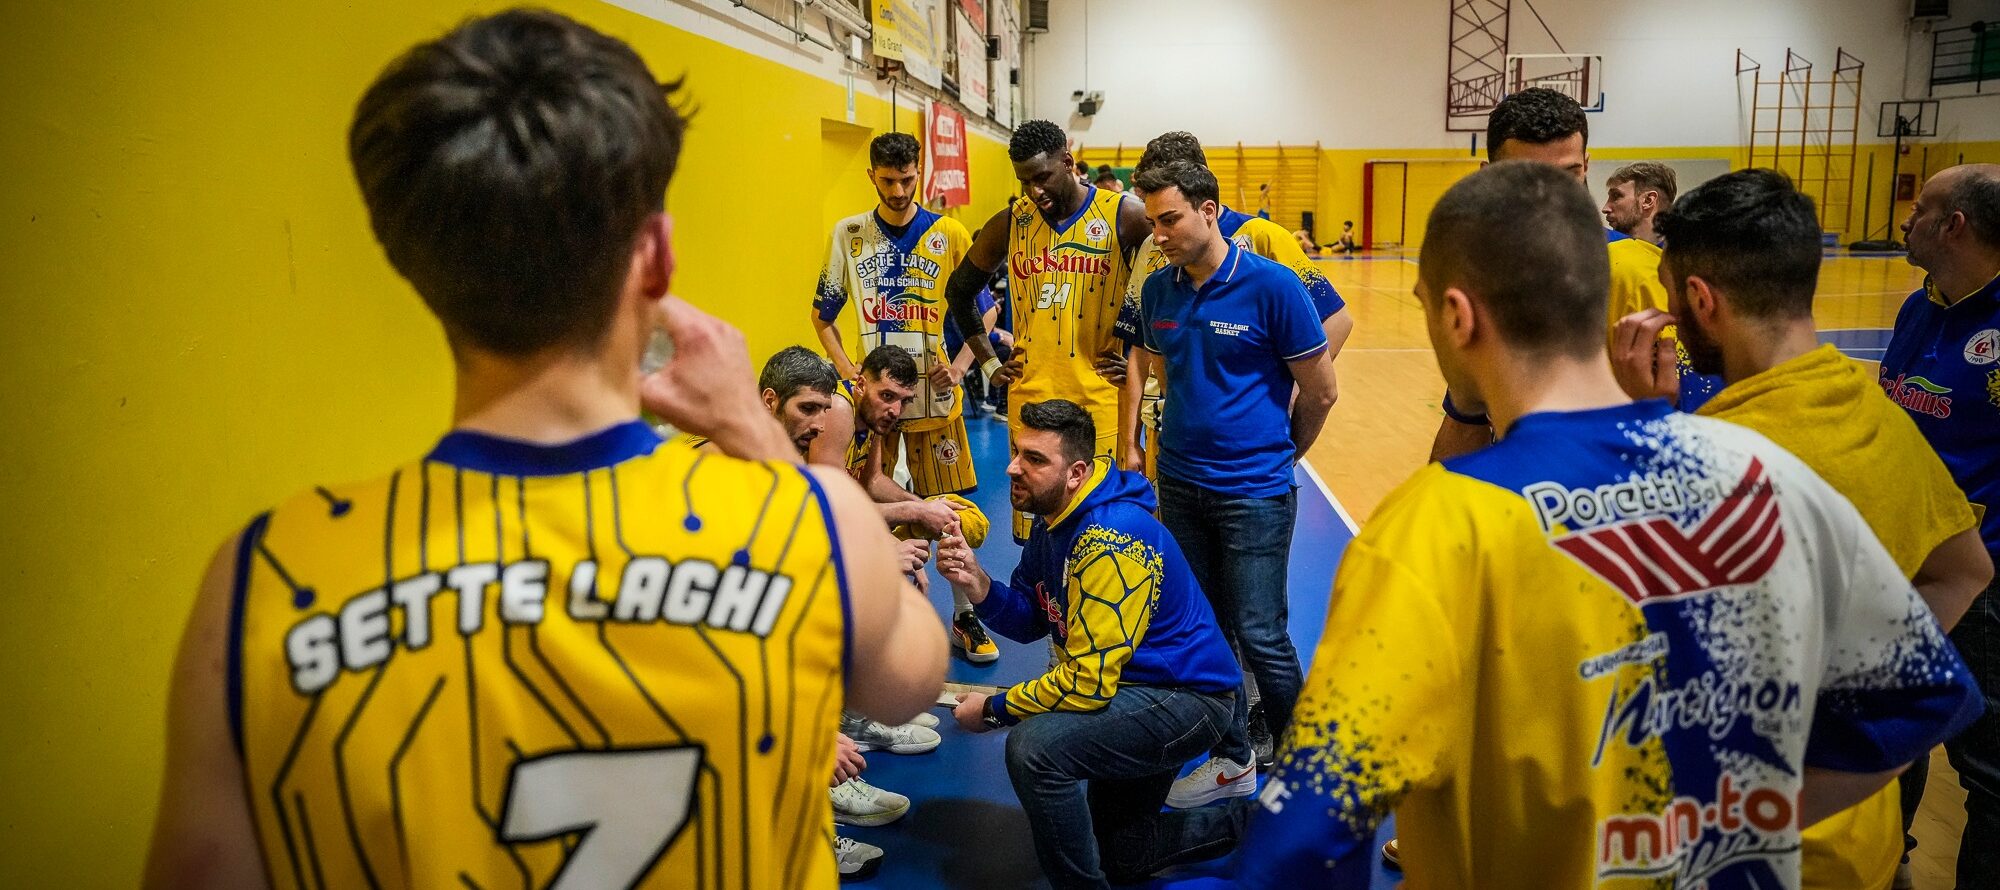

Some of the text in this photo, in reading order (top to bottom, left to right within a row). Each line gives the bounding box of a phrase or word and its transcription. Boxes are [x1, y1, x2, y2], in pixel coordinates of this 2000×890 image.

[850, 237, 863, 258] 9
[856, 253, 940, 280] SETE LAGHI
[1037, 282, 1072, 309] 34
[1210, 320, 1250, 331] SETTE LAGHI
[1215, 328, 1239, 337] BASKET
[1526, 473, 1681, 532] Poretti
[285, 555, 793, 694] SETTE LAGHI
[500, 743, 705, 890] 7
